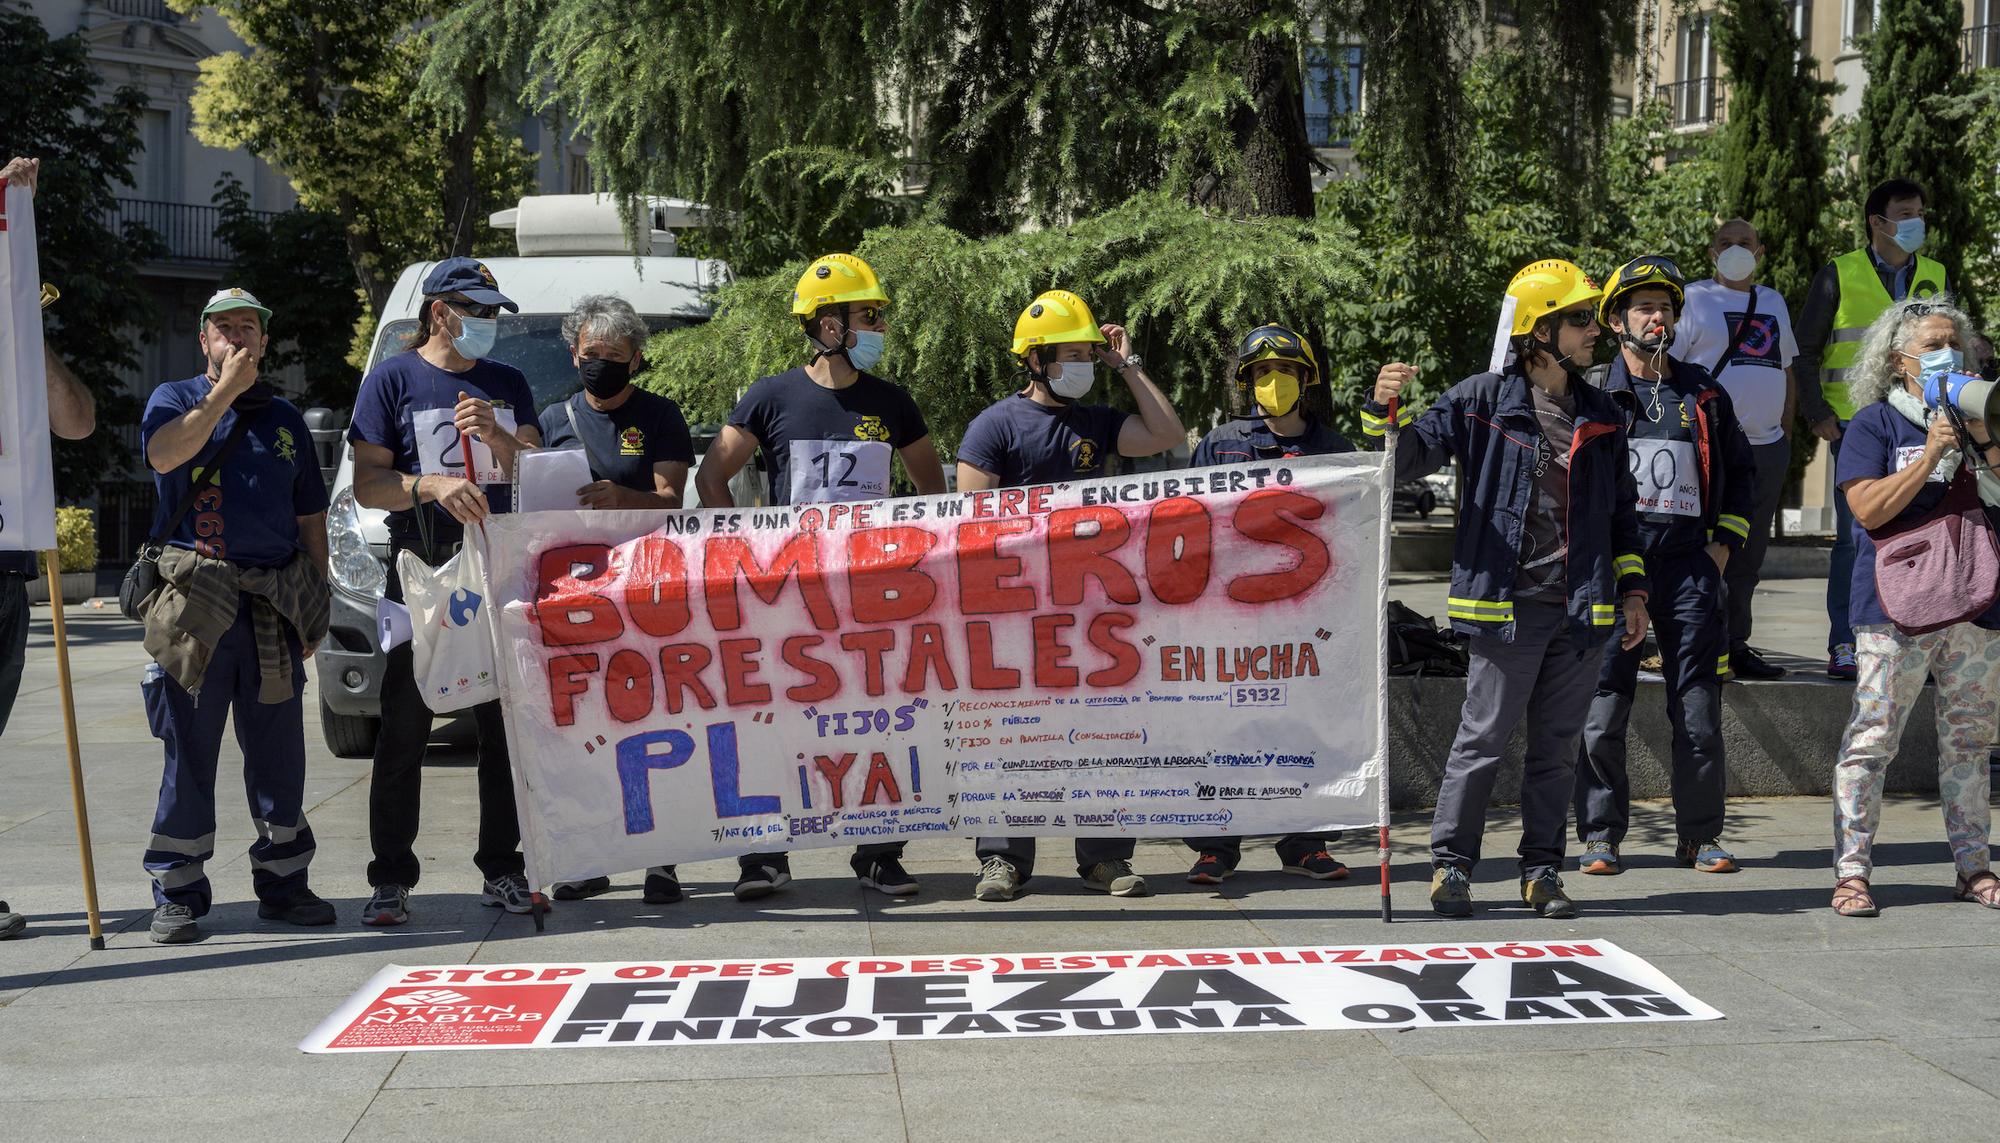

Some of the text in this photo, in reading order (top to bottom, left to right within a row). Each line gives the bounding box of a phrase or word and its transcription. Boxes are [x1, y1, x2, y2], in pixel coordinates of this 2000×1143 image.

[811, 452, 858, 488] 12
[861, 481, 882, 491] AÑOS
[1679, 484, 1697, 497] AÑOS
[666, 514, 701, 536] NO
[713, 514, 741, 533] ES
[753, 514, 790, 529] UNA
[892, 502, 926, 521] ES
[937, 500, 962, 518] UN
[1081, 467, 1294, 507] ENCUBIERTO
[1664, 500, 1675, 508] DE
[1680, 501, 1695, 511] LEY
[536, 489, 1331, 647] BOMBEROS
[547, 612, 1141, 726] FORESTALES
[1132, 695, 1141, 703] DE
[1237, 687, 1280, 703] 5932
[1000, 737, 1013, 745] EN
[961, 762, 979, 771] POR
[984, 762, 995, 770] EL
[1078, 758, 1089, 767] DE
[1092, 757, 1103, 766] LA
[1106, 756, 1161, 767] NORMATIVA
[961, 792, 996, 802] PORQUE
[1003, 792, 1016, 800] LA
[1072, 790, 1091, 799] SEA
[1097, 790, 1120, 798] PARA
[1124, 789, 1135, 797] EL
[1220, 786, 1243, 796] PARA
[1247, 786, 1257, 796] EL
[842, 810, 886, 820] CONCURSO
[964, 816, 982, 825] POR
[988, 816, 998, 824] EL
[1055, 815, 1066, 824] AL
[1136, 813, 1147, 821] 35
[767, 824, 783, 833] DEL
[400, 942, 1604, 984] STOP OPES (DES)ESTABILIZACIÓN
[567, 960, 1664, 1021] FIJEZA YA
[369, 1005, 515, 1016] ATPTN
[361, 1012, 543, 1025] NABLPB
[551, 996, 1693, 1043] FINKOTASUNA ORAIN
